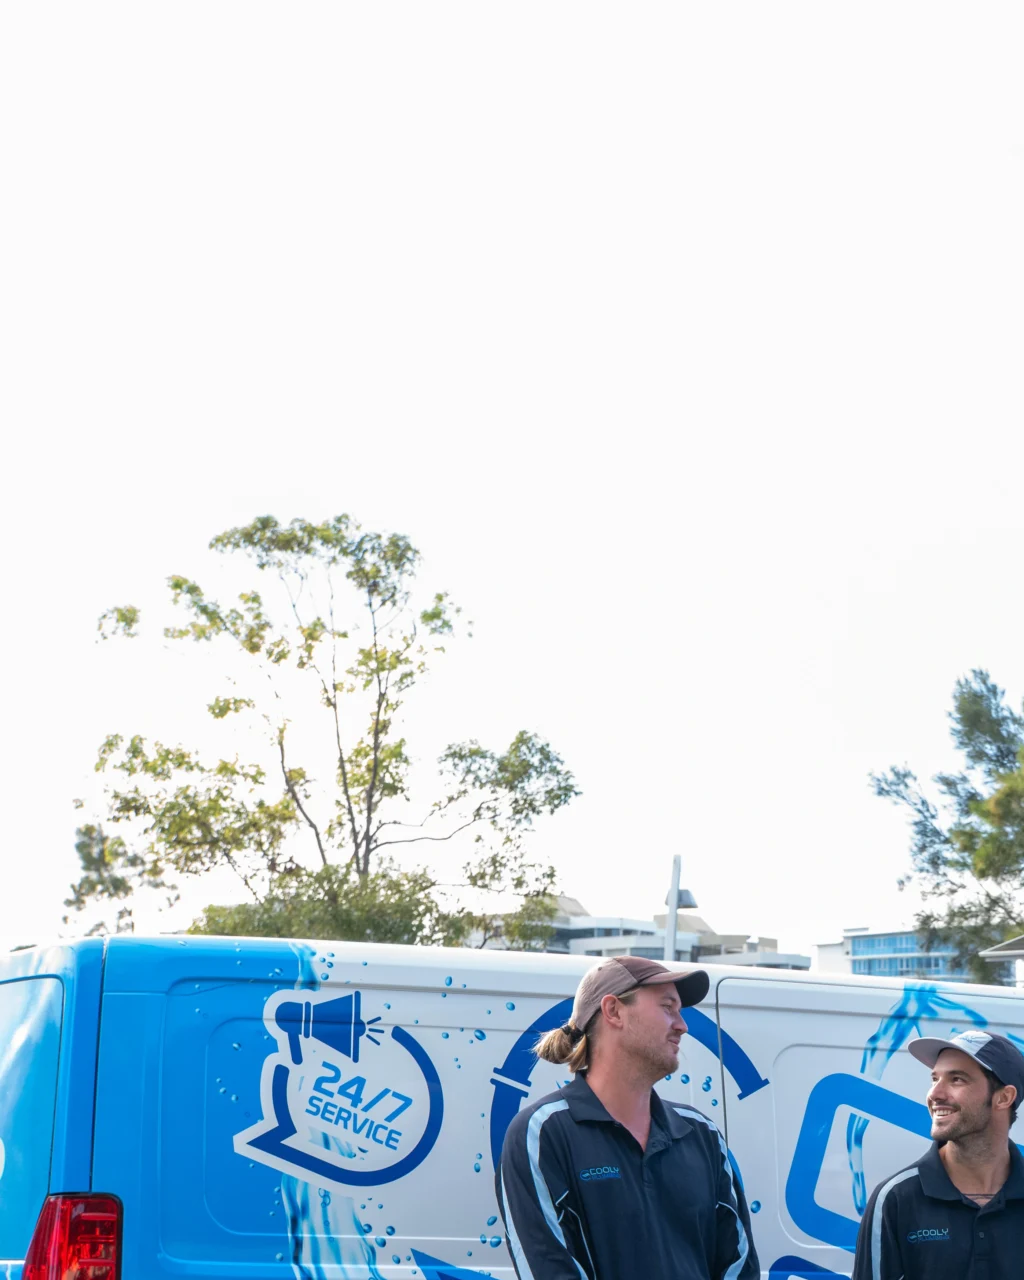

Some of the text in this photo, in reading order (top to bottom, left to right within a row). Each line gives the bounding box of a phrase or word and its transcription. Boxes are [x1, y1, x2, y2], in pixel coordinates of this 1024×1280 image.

[313, 1061, 413, 1123] 24/7
[305, 1095, 402, 1151] SERVICE
[589, 1166, 619, 1175] COOLY
[917, 1227, 949, 1237] COOLY
